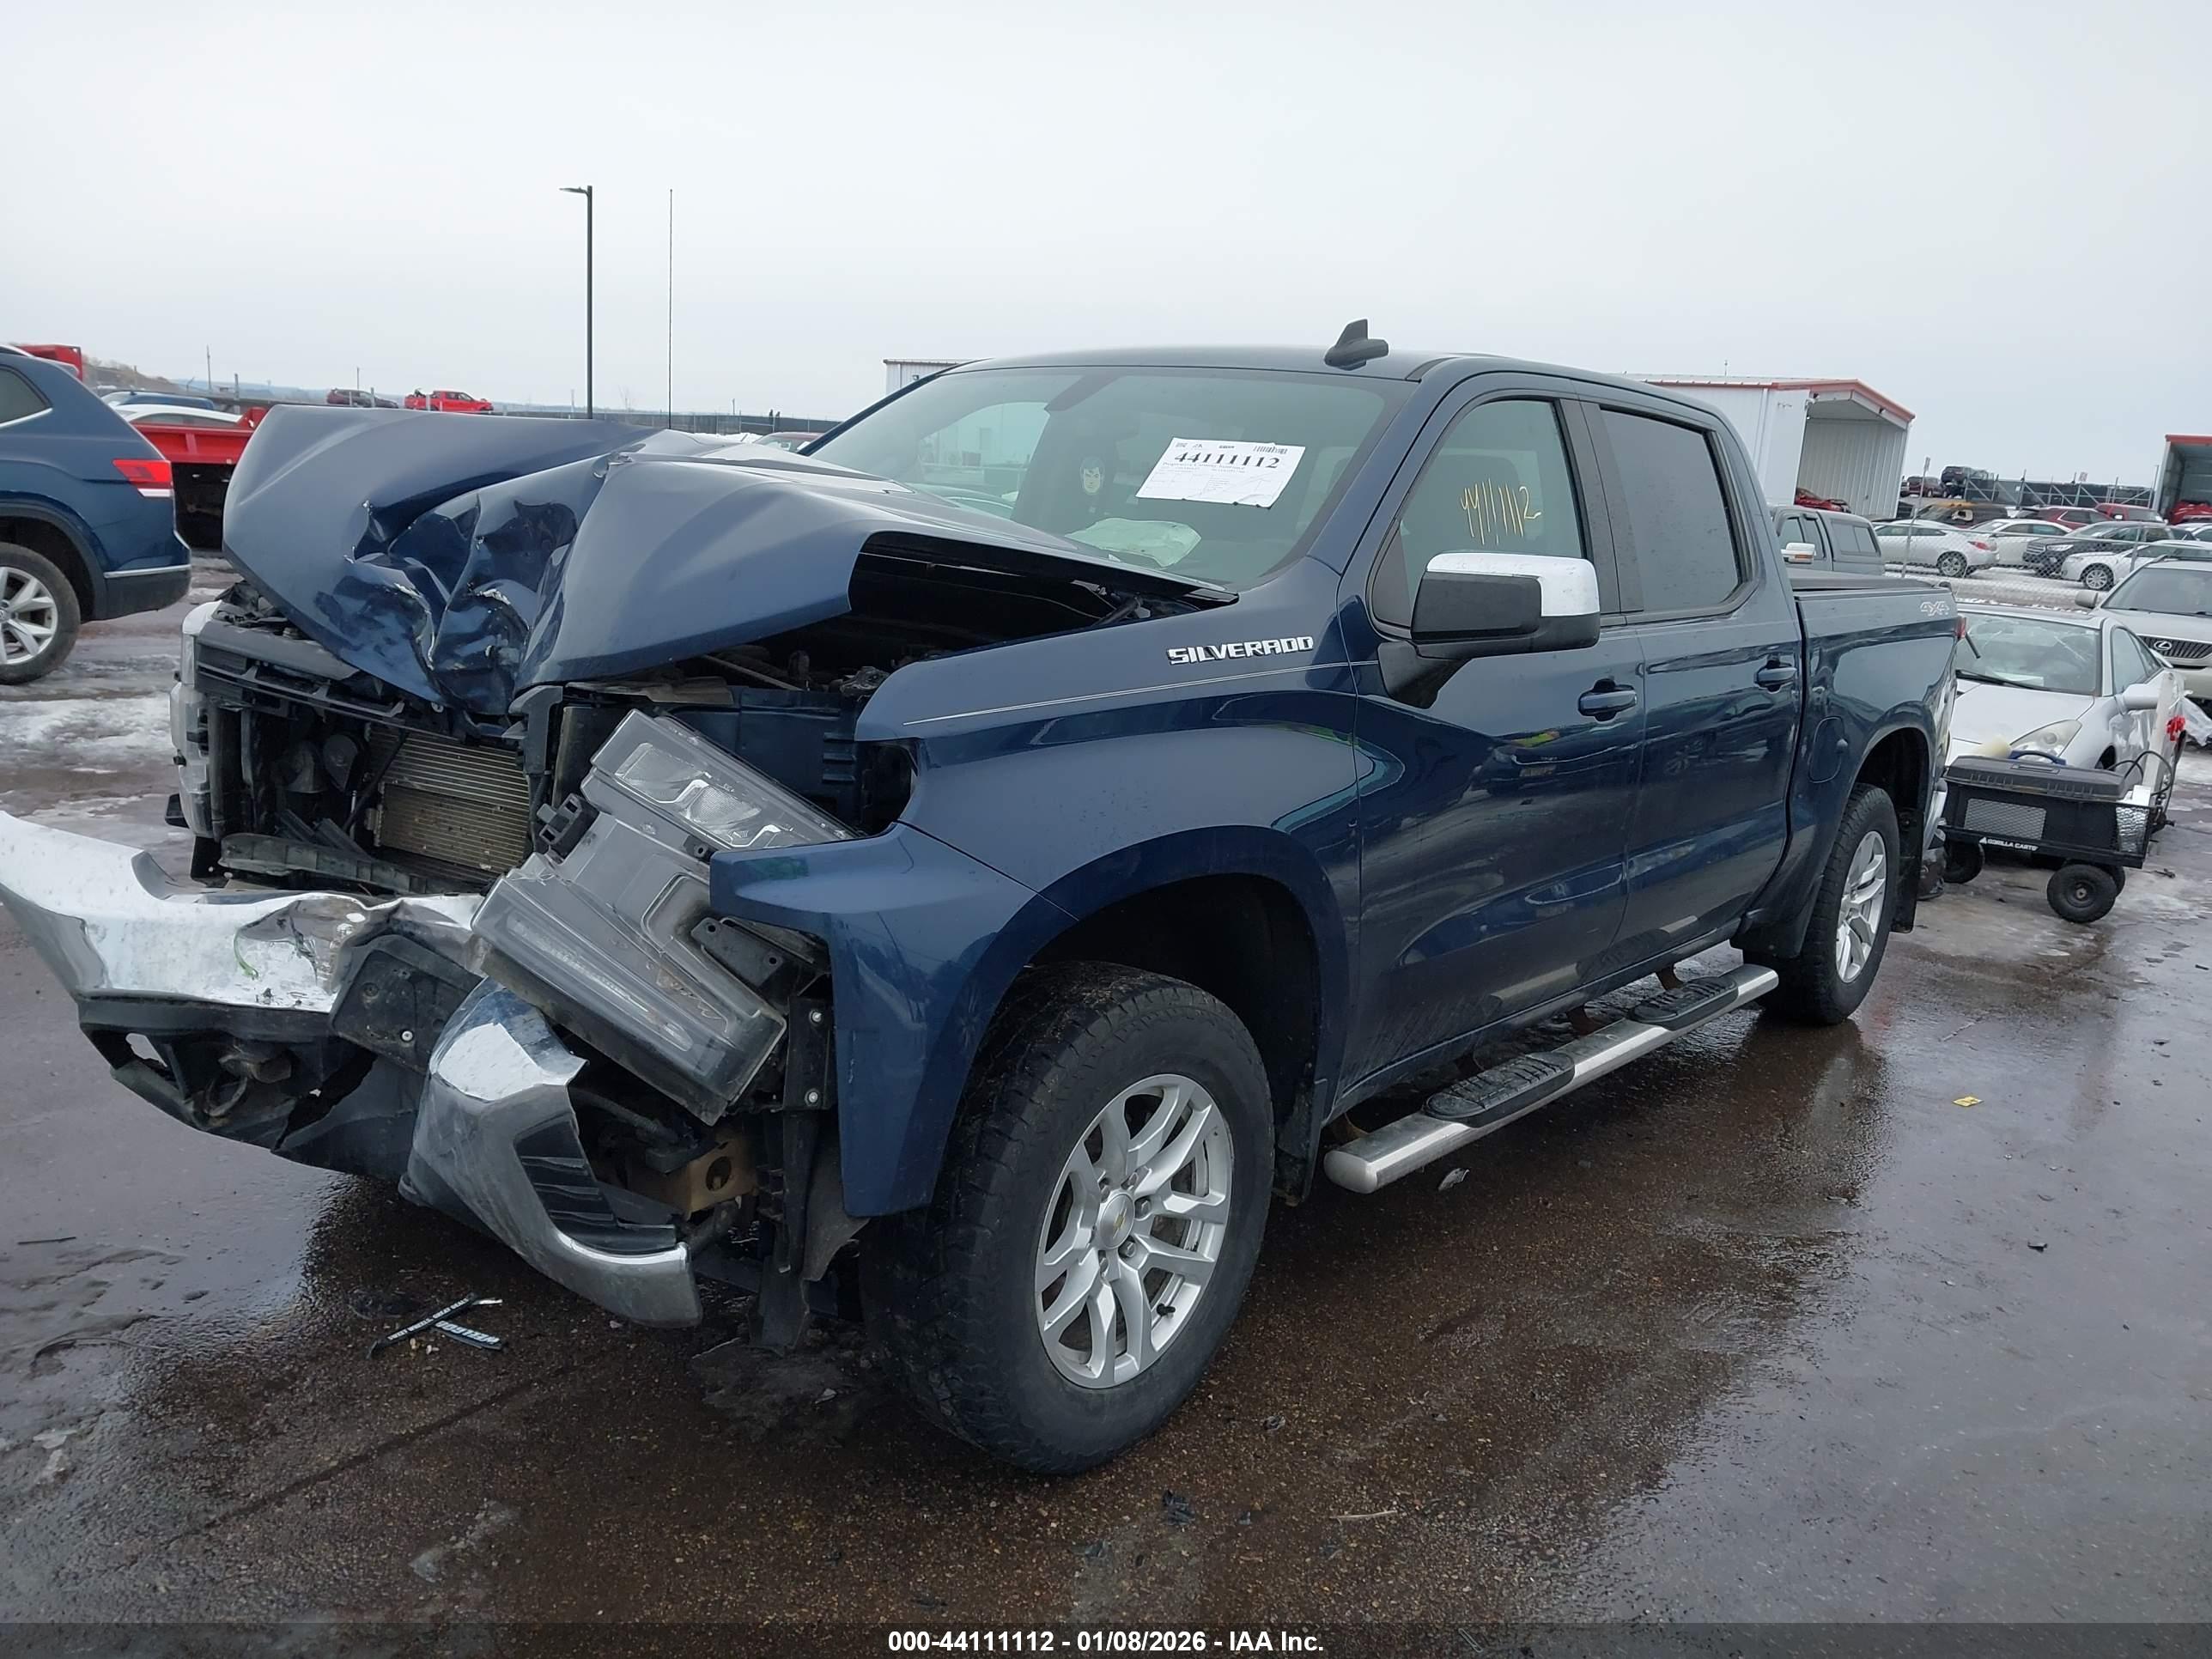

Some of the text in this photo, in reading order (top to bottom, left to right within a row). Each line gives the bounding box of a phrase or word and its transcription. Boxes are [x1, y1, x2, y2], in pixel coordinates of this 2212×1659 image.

[1175, 452, 1280, 469] 44111112
[1167, 635, 1314, 665] SILVERADO
[1987, 838, 2014, 848] GORILLA
